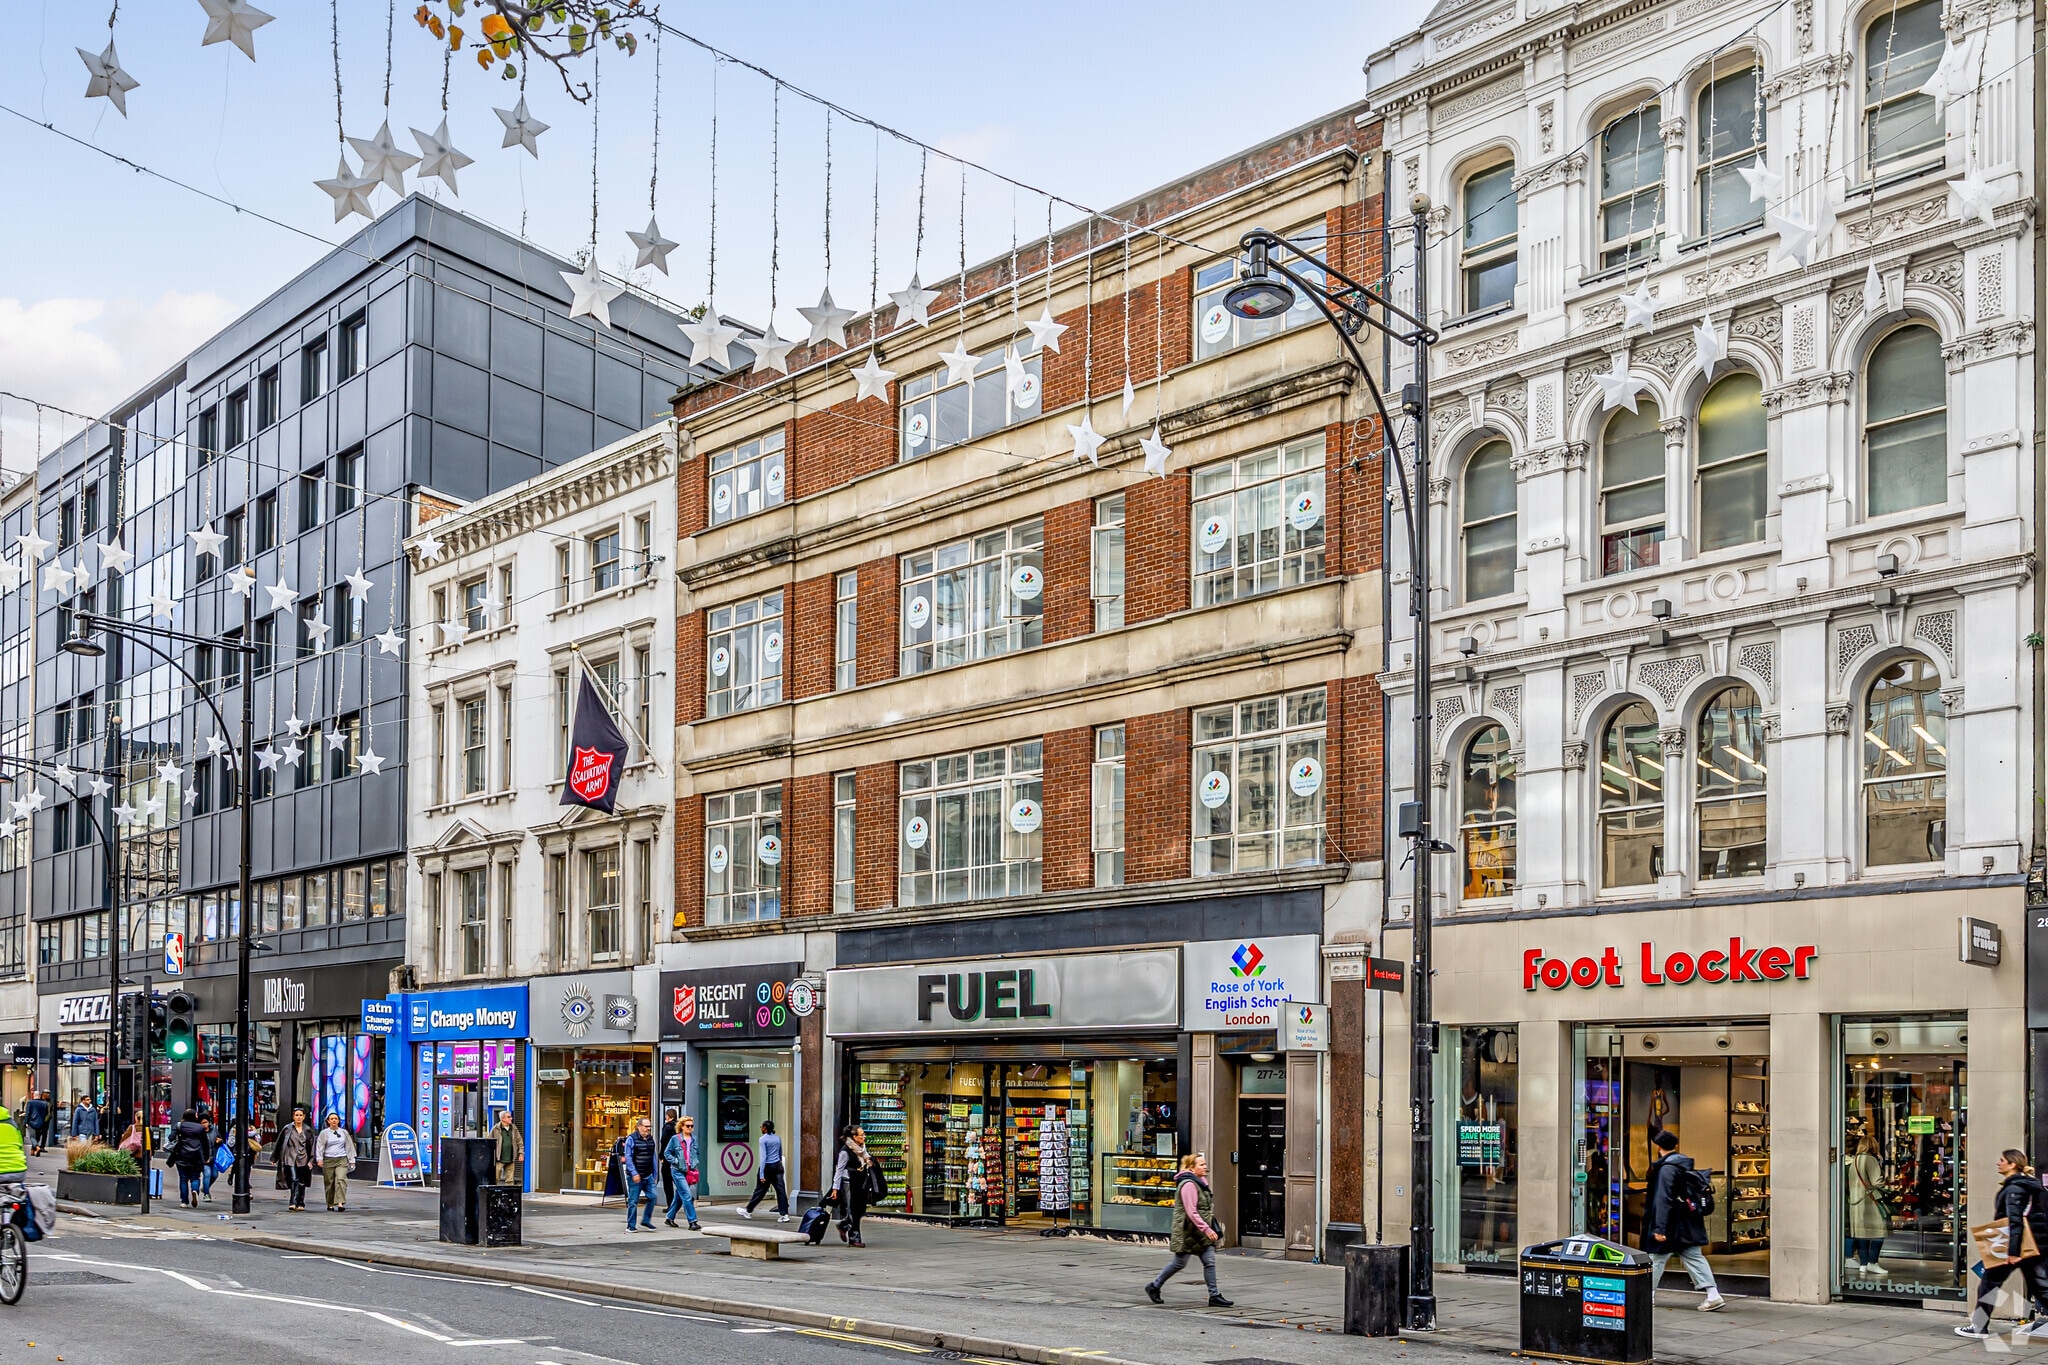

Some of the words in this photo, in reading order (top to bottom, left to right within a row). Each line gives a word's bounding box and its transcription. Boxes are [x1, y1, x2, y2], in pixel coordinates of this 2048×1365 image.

[583, 755, 594, 767] THE
[574, 761, 608, 784] SALVATION
[585, 776, 604, 794] ARMY
[1522, 946, 1624, 991] Foot
[1640, 936, 1819, 986] Locker
[1374, 969, 1385, 978] Foot
[1386, 970, 1401, 980] Locker
[699, 984, 746, 1002] REGENT
[1211, 982, 1239, 993] Rose
[1243, 979, 1255, 992] of
[1258, 978, 1284, 991] York
[264, 978, 282, 1014] NBA
[283, 977, 305, 1012] Store
[674, 992, 694, 1014] SALVATION
[918, 969, 1052, 1022] FUEL
[58, 994, 122, 1024] SKECH
[367, 1003, 392, 1014] atm
[681, 1003, 693, 1019] ARMY
[699, 1003, 729, 1019] HALL
[1205, 996, 1247, 1012] English
[365, 1016, 394, 1024] Change
[430, 1010, 474, 1030] Change
[476, 1008, 516, 1029] Money
[1225, 1012, 1270, 1025] London
[366, 1024, 392, 1033] Money
[495, 1067, 509, 1076] atm
[1257, 1070, 1286, 1080] 277-2
[977, 1080, 994, 1088] WH
[1461, 1250, 1500, 1263] Locker
[1848, 1277, 1882, 1292] Foot
[1887, 1279, 1940, 1295] Locker
